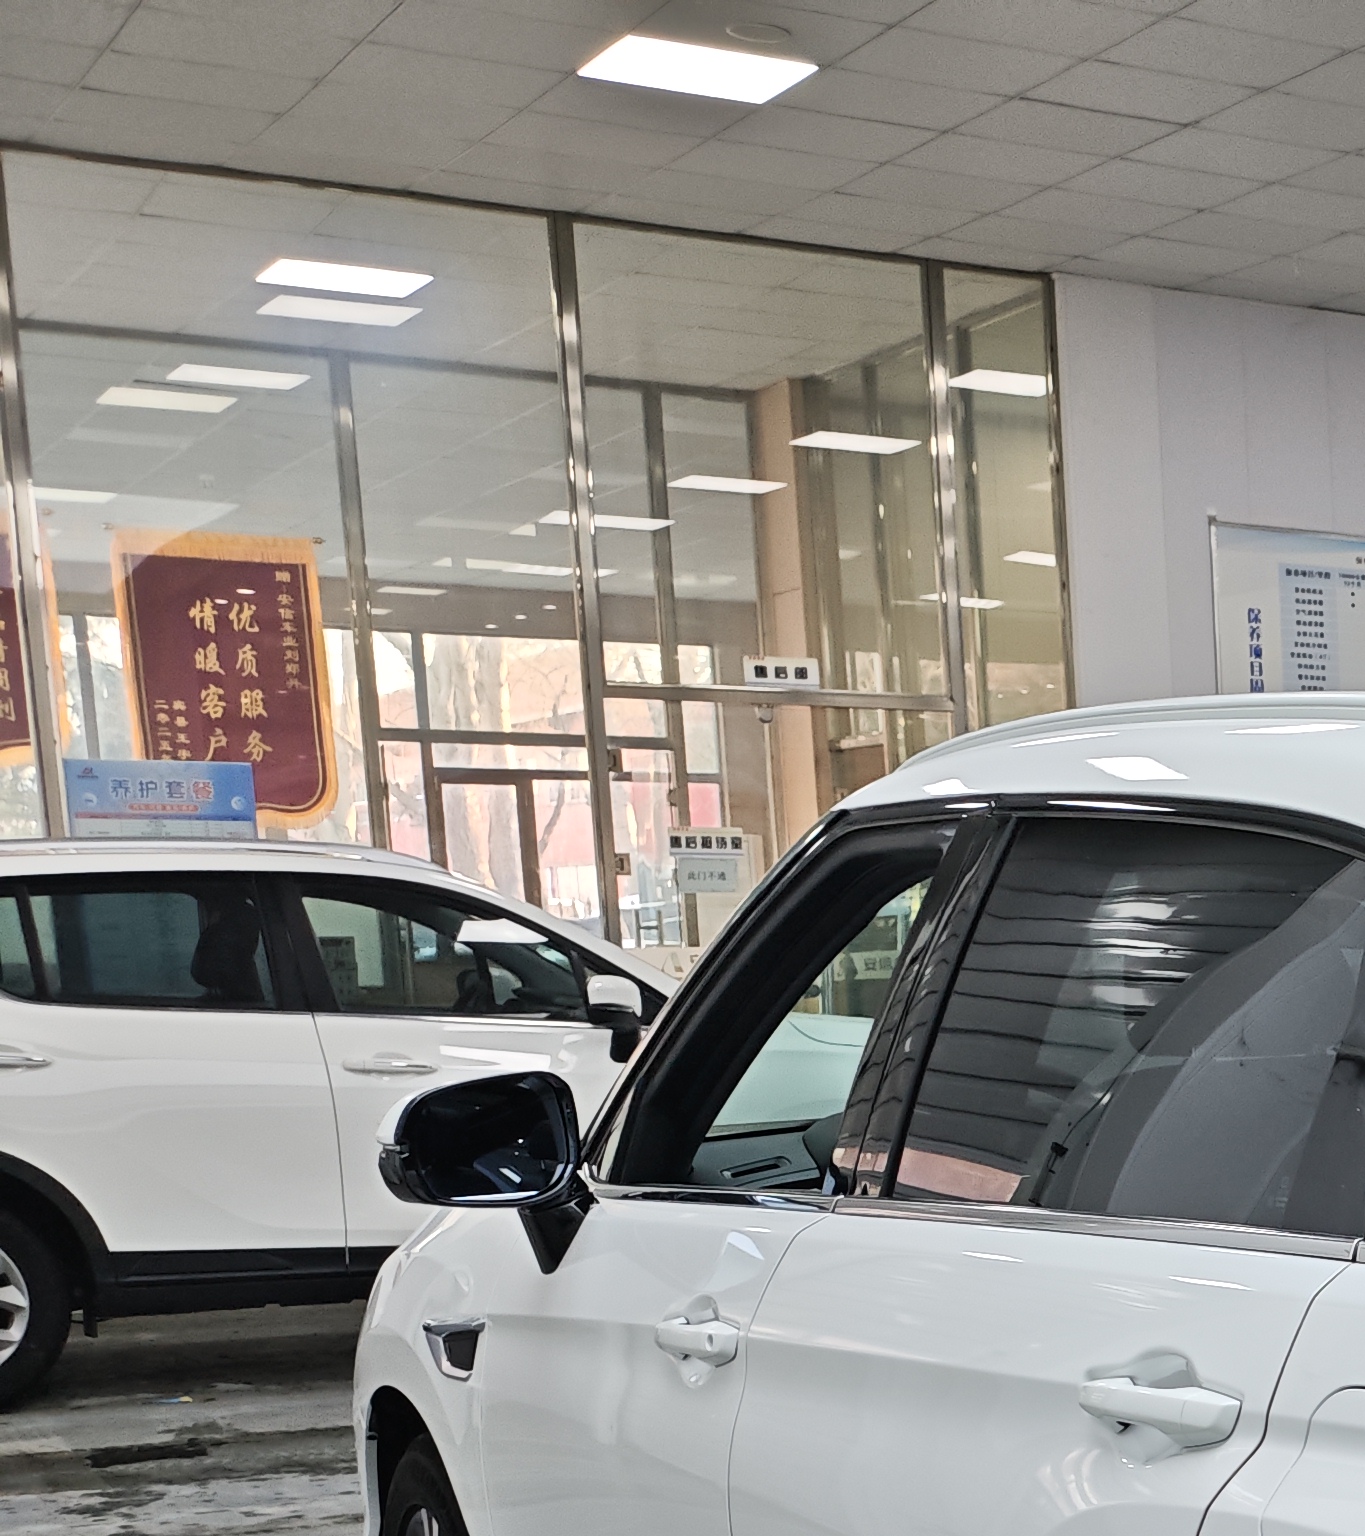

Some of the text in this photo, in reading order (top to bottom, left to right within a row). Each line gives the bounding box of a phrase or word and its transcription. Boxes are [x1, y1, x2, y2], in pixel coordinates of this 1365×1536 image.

[188, 596, 229, 761] 情暖客户
[228, 600, 273, 763] 优质服务
[110, 778, 214, 801] 养护套餐
